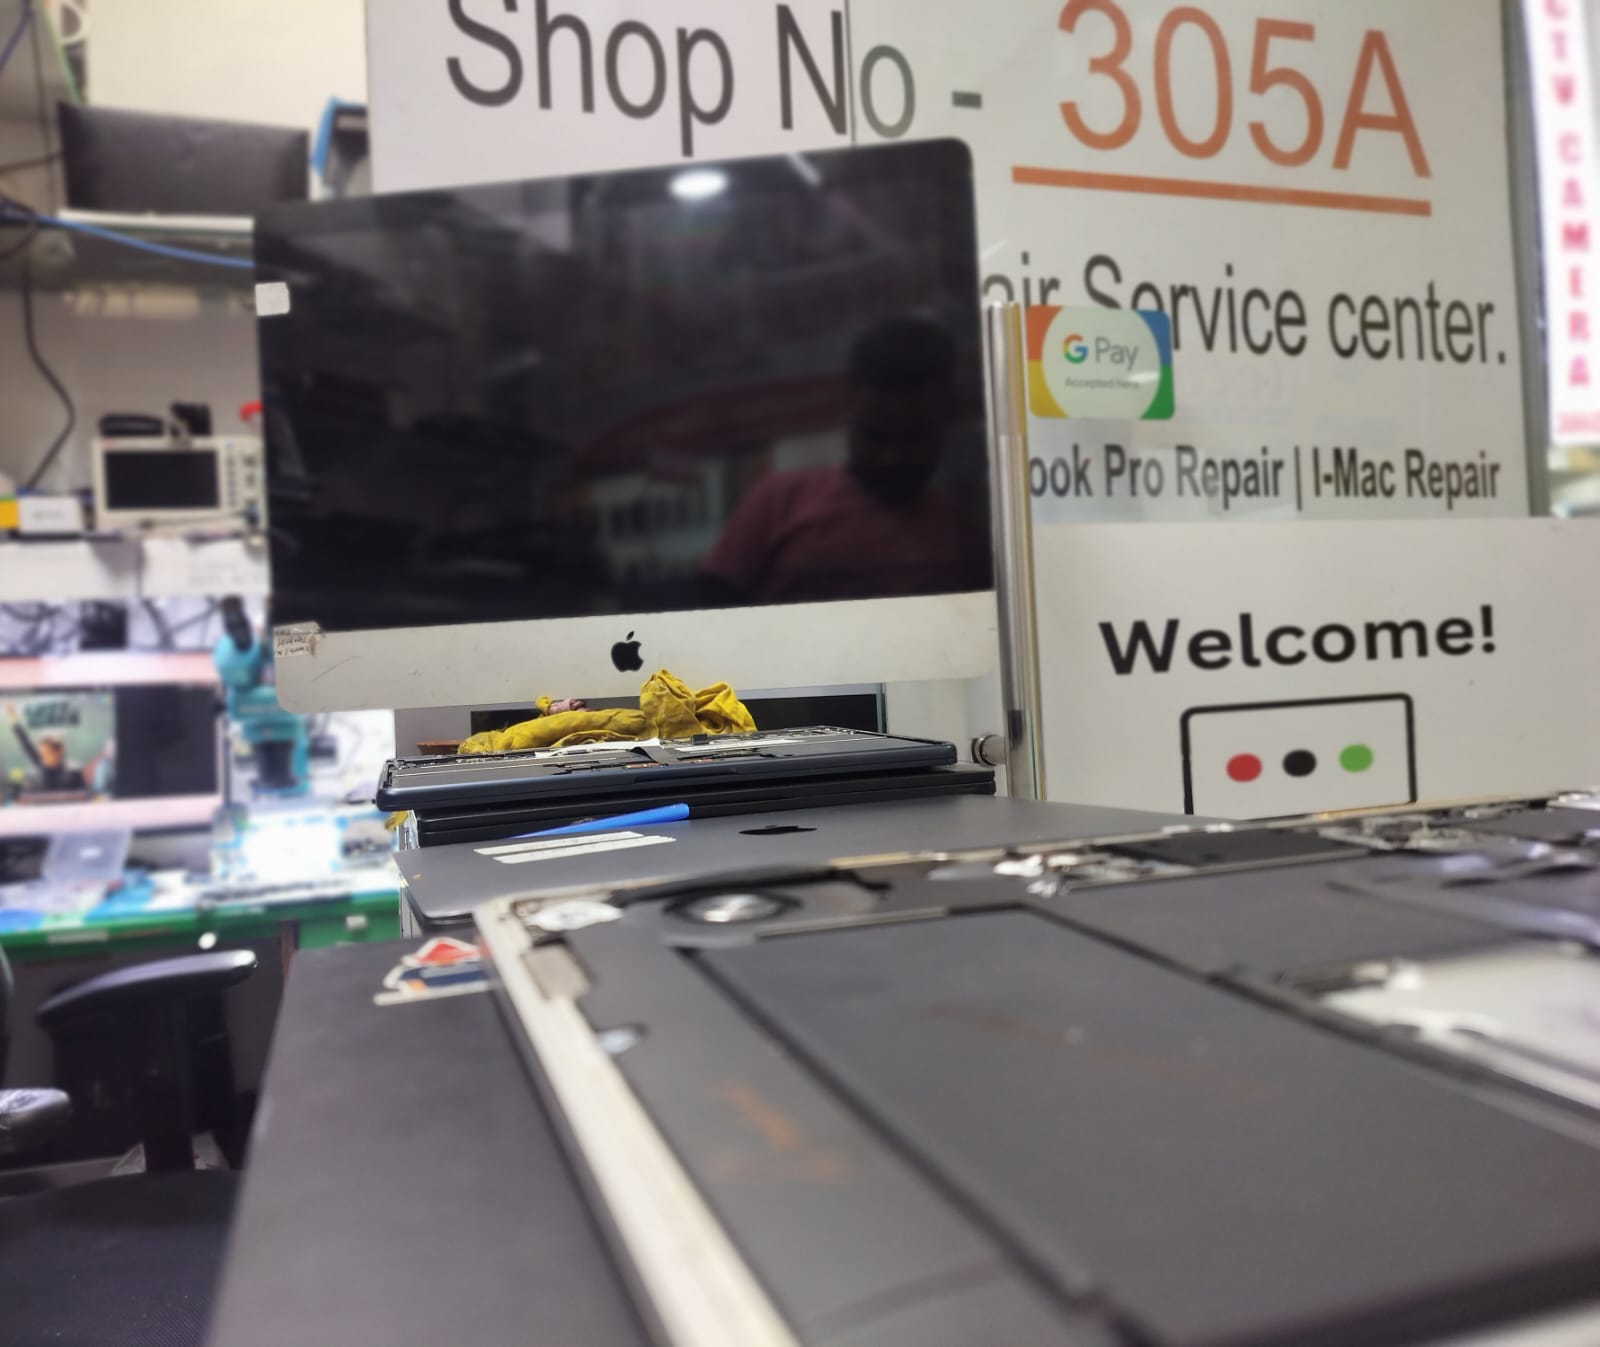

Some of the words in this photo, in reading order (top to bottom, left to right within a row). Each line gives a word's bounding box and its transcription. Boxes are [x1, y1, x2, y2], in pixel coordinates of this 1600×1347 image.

[446, 0, 734, 158] Shop
[776, 3, 916, 139] No
[1058, 0, 1432, 179] 305A
[1558, 132, 1591, 388] CAMERA
[1062, 333, 1089, 364] G
[1095, 336, 1139, 371] Pay
[1328, 280, 1506, 365] center.
[1065, 376, 1115, 390] Accepted
[1104, 444, 1165, 498] Pro
[1175, 444, 1284, 511] Repair
[1313, 446, 1396, 499] I-Mac
[1405, 447, 1501, 512] Repair
[1098, 604, 1496, 676] Welcome!
